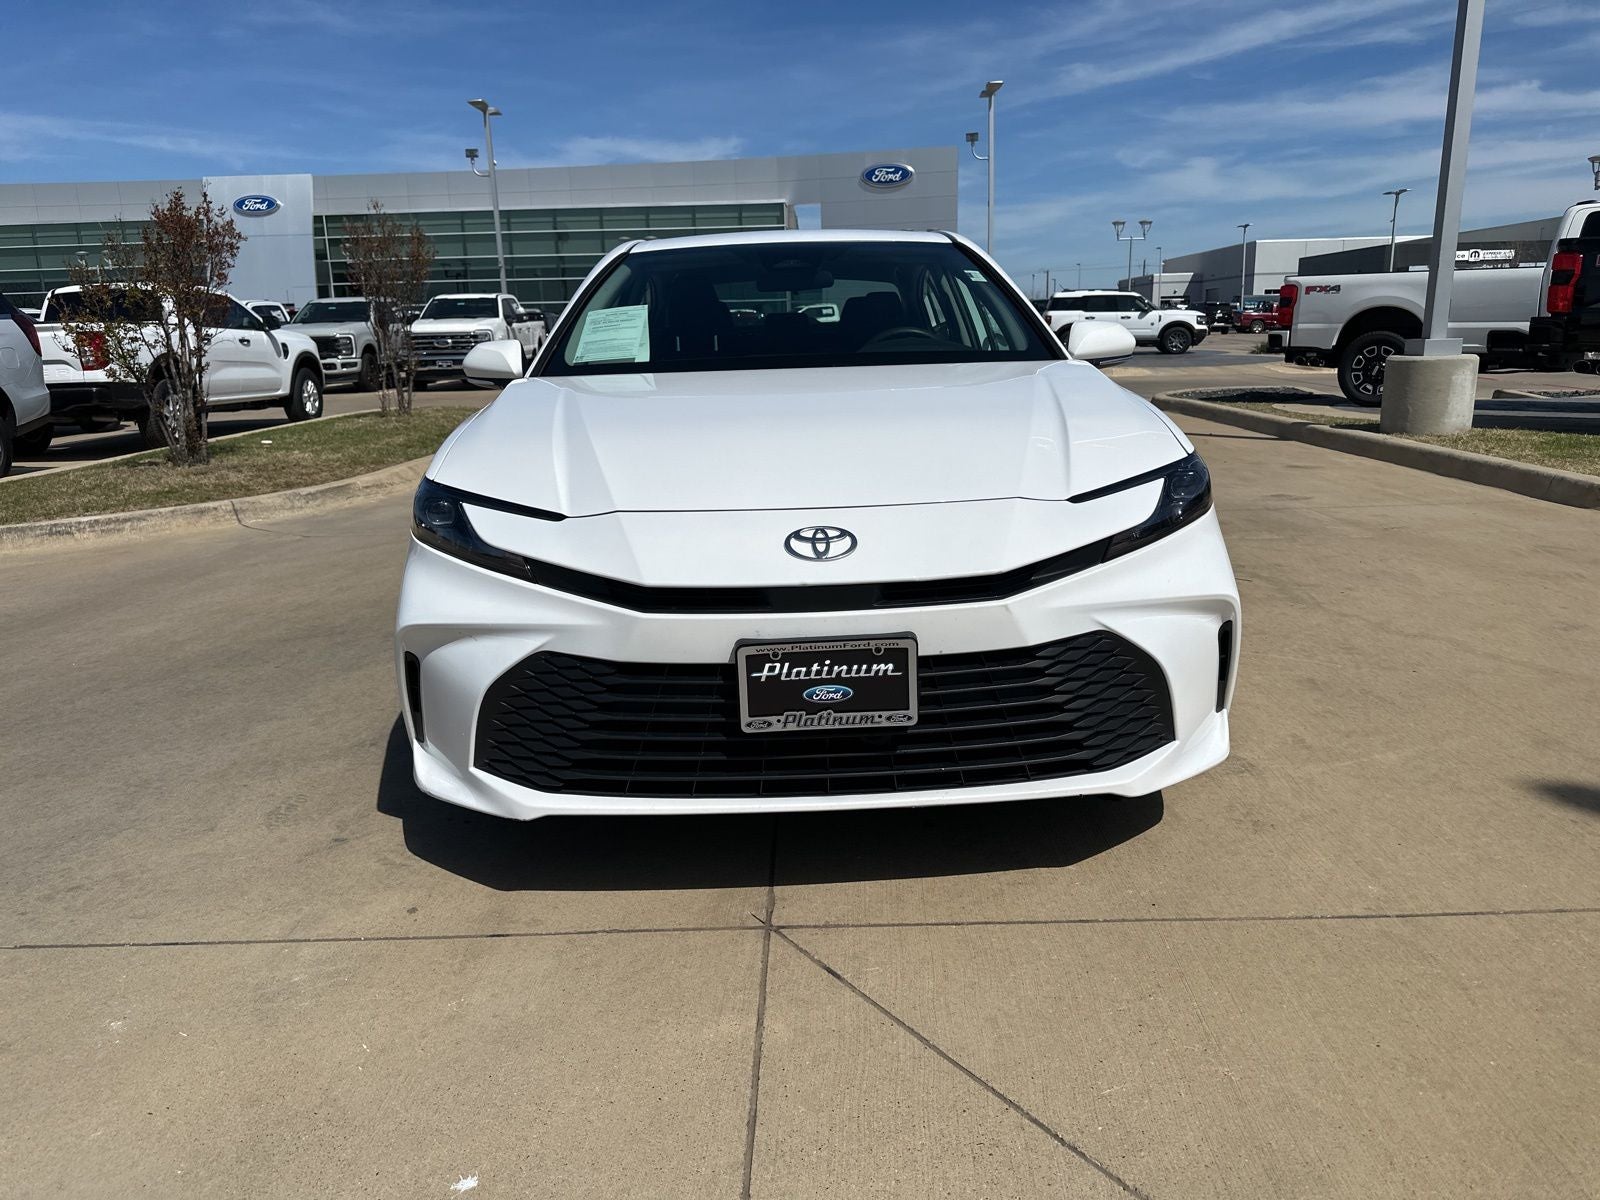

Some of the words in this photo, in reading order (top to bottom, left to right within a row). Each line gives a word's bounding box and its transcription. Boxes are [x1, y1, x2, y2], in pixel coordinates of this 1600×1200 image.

[872, 168, 902, 181] Ford
[242, 199, 268, 210] Ford
[1305, 285, 1341, 295] FX4
[755, 641, 900, 653] www.PlatinumFord.com
[751, 660, 903, 682] Platinum
[813, 687, 844, 700] Ford
[782, 711, 882, 729] Platinum
